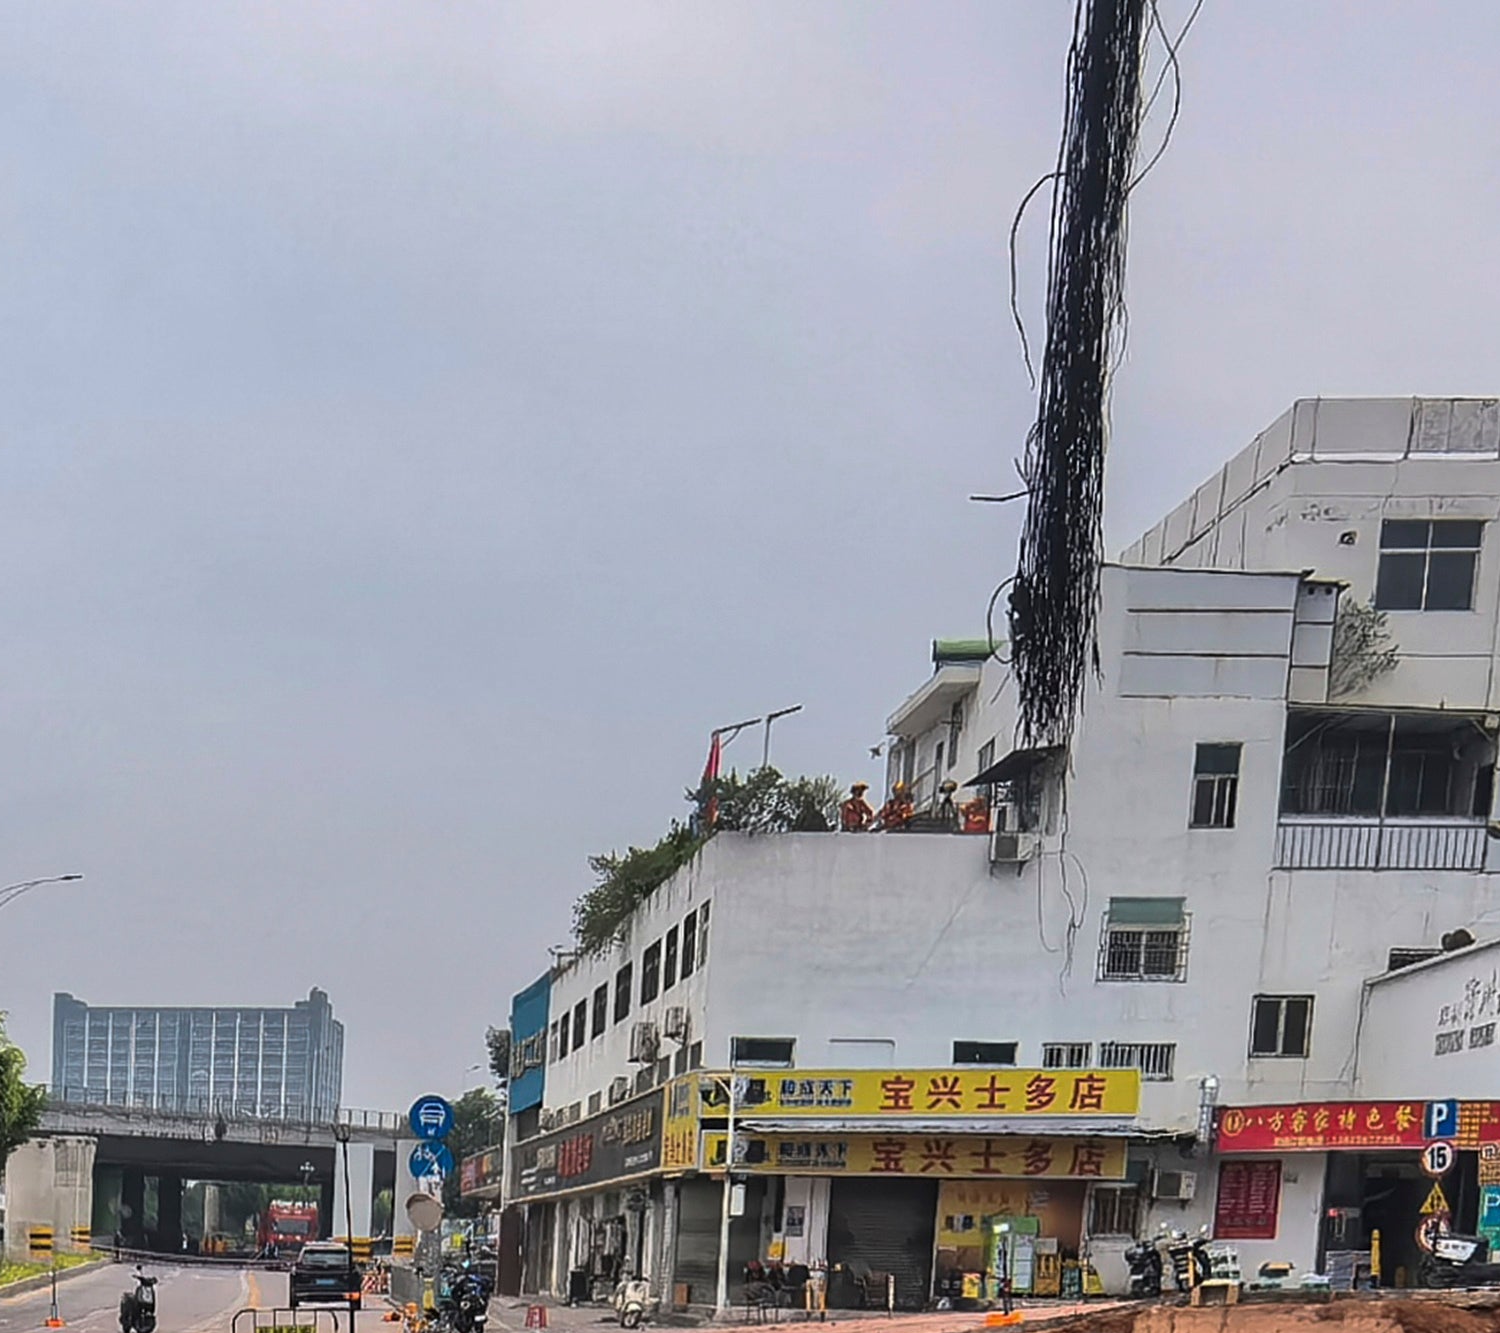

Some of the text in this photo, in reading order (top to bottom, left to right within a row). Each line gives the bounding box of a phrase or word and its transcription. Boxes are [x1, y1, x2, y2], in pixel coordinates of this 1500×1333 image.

[879, 1073, 1106, 1111] 宝兴士多店
[1245, 1106, 1423, 1133] 八方客家特色餐
[1430, 1102, 1448, 1136] P
[869, 1137, 1106, 1176] 宝兴士多店
[1428, 1146, 1447, 1170] 15
